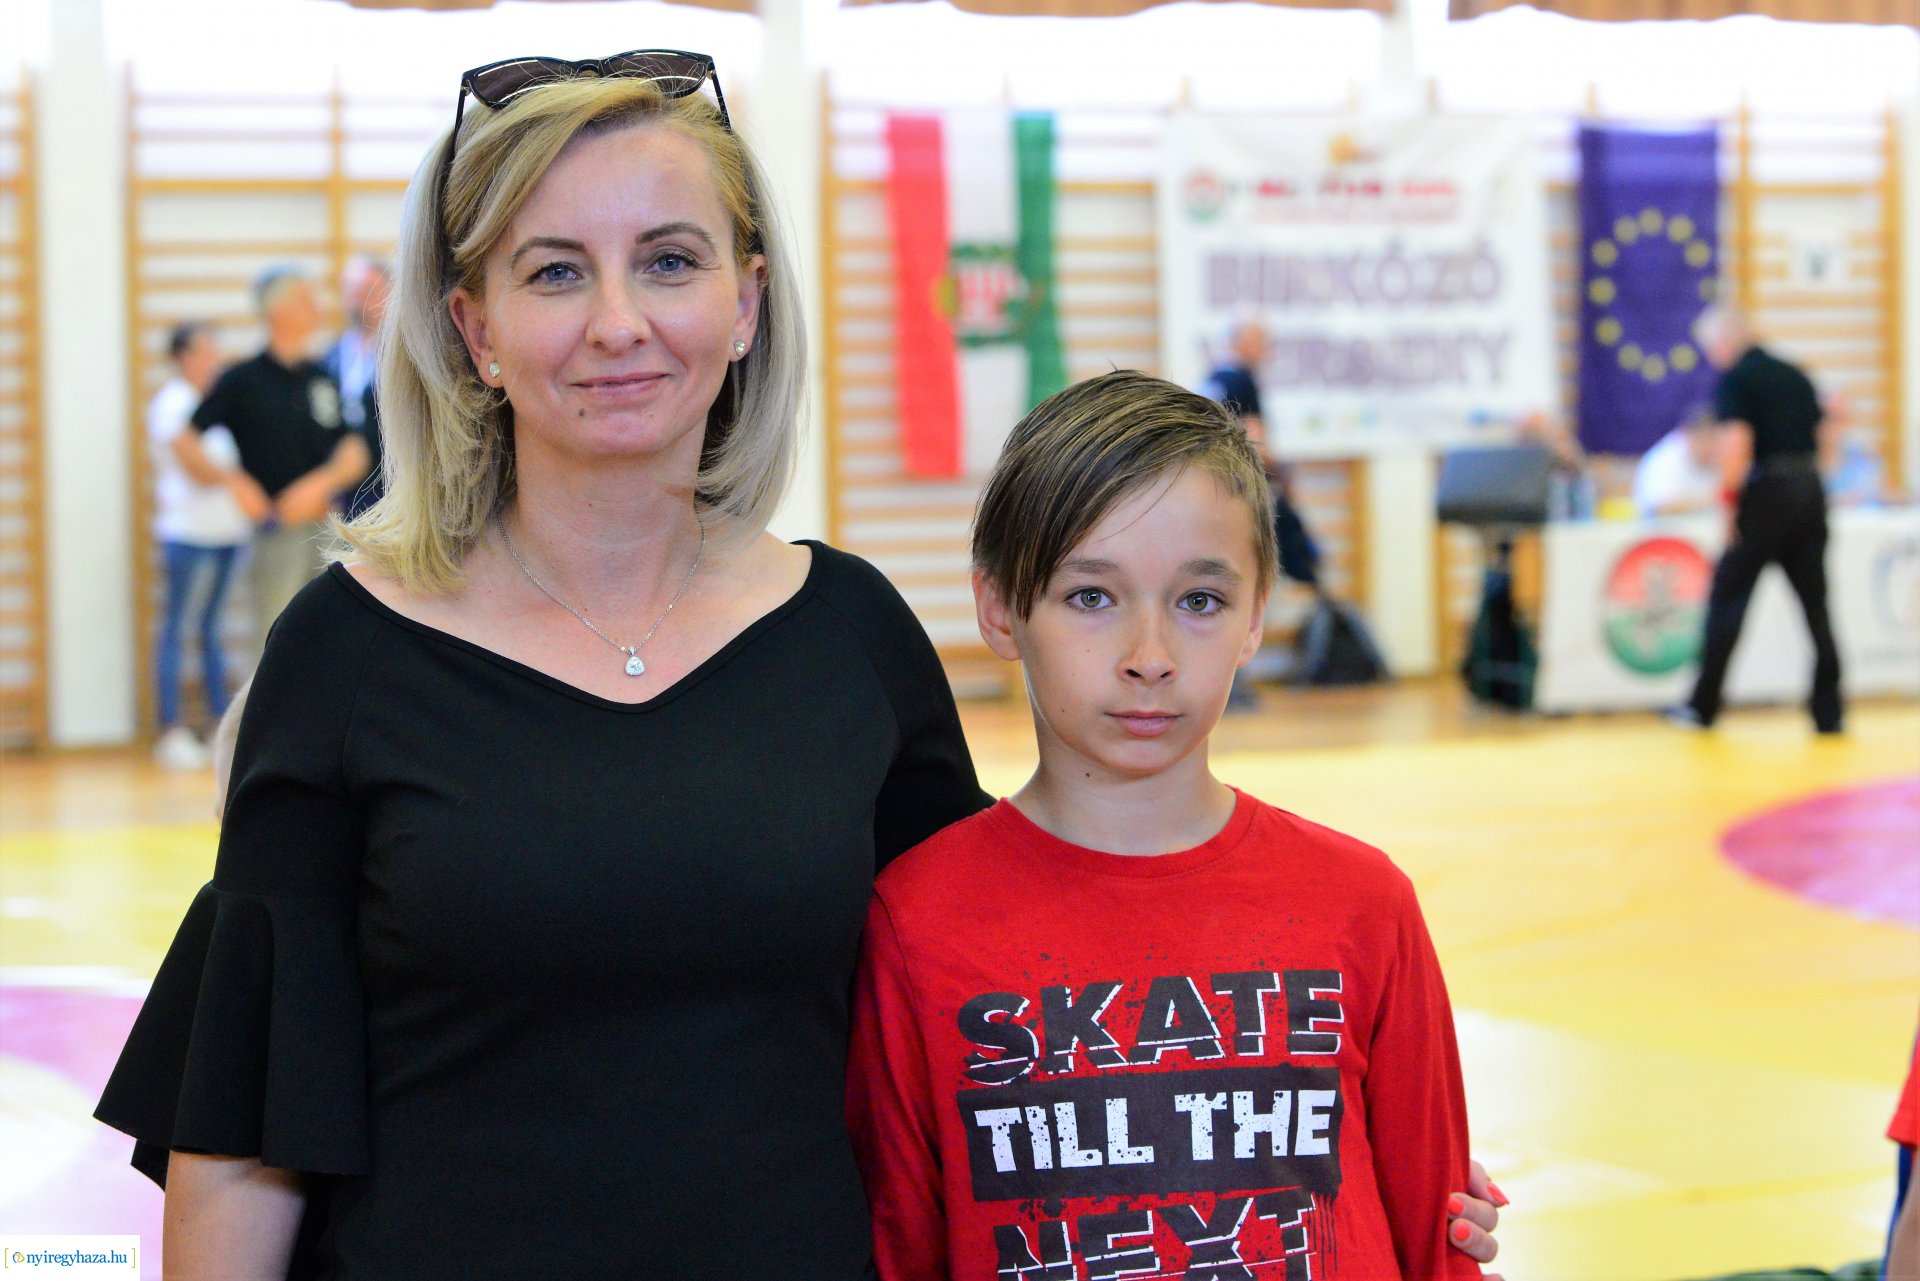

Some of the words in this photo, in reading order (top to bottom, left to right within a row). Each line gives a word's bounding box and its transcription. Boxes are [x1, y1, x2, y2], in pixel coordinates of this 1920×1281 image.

[957, 969, 1345, 1086] SKATE
[974, 1097, 1155, 1173] TILL
[1174, 1089, 1337, 1162] THE
[993, 1190, 1316, 1281] NEXT
